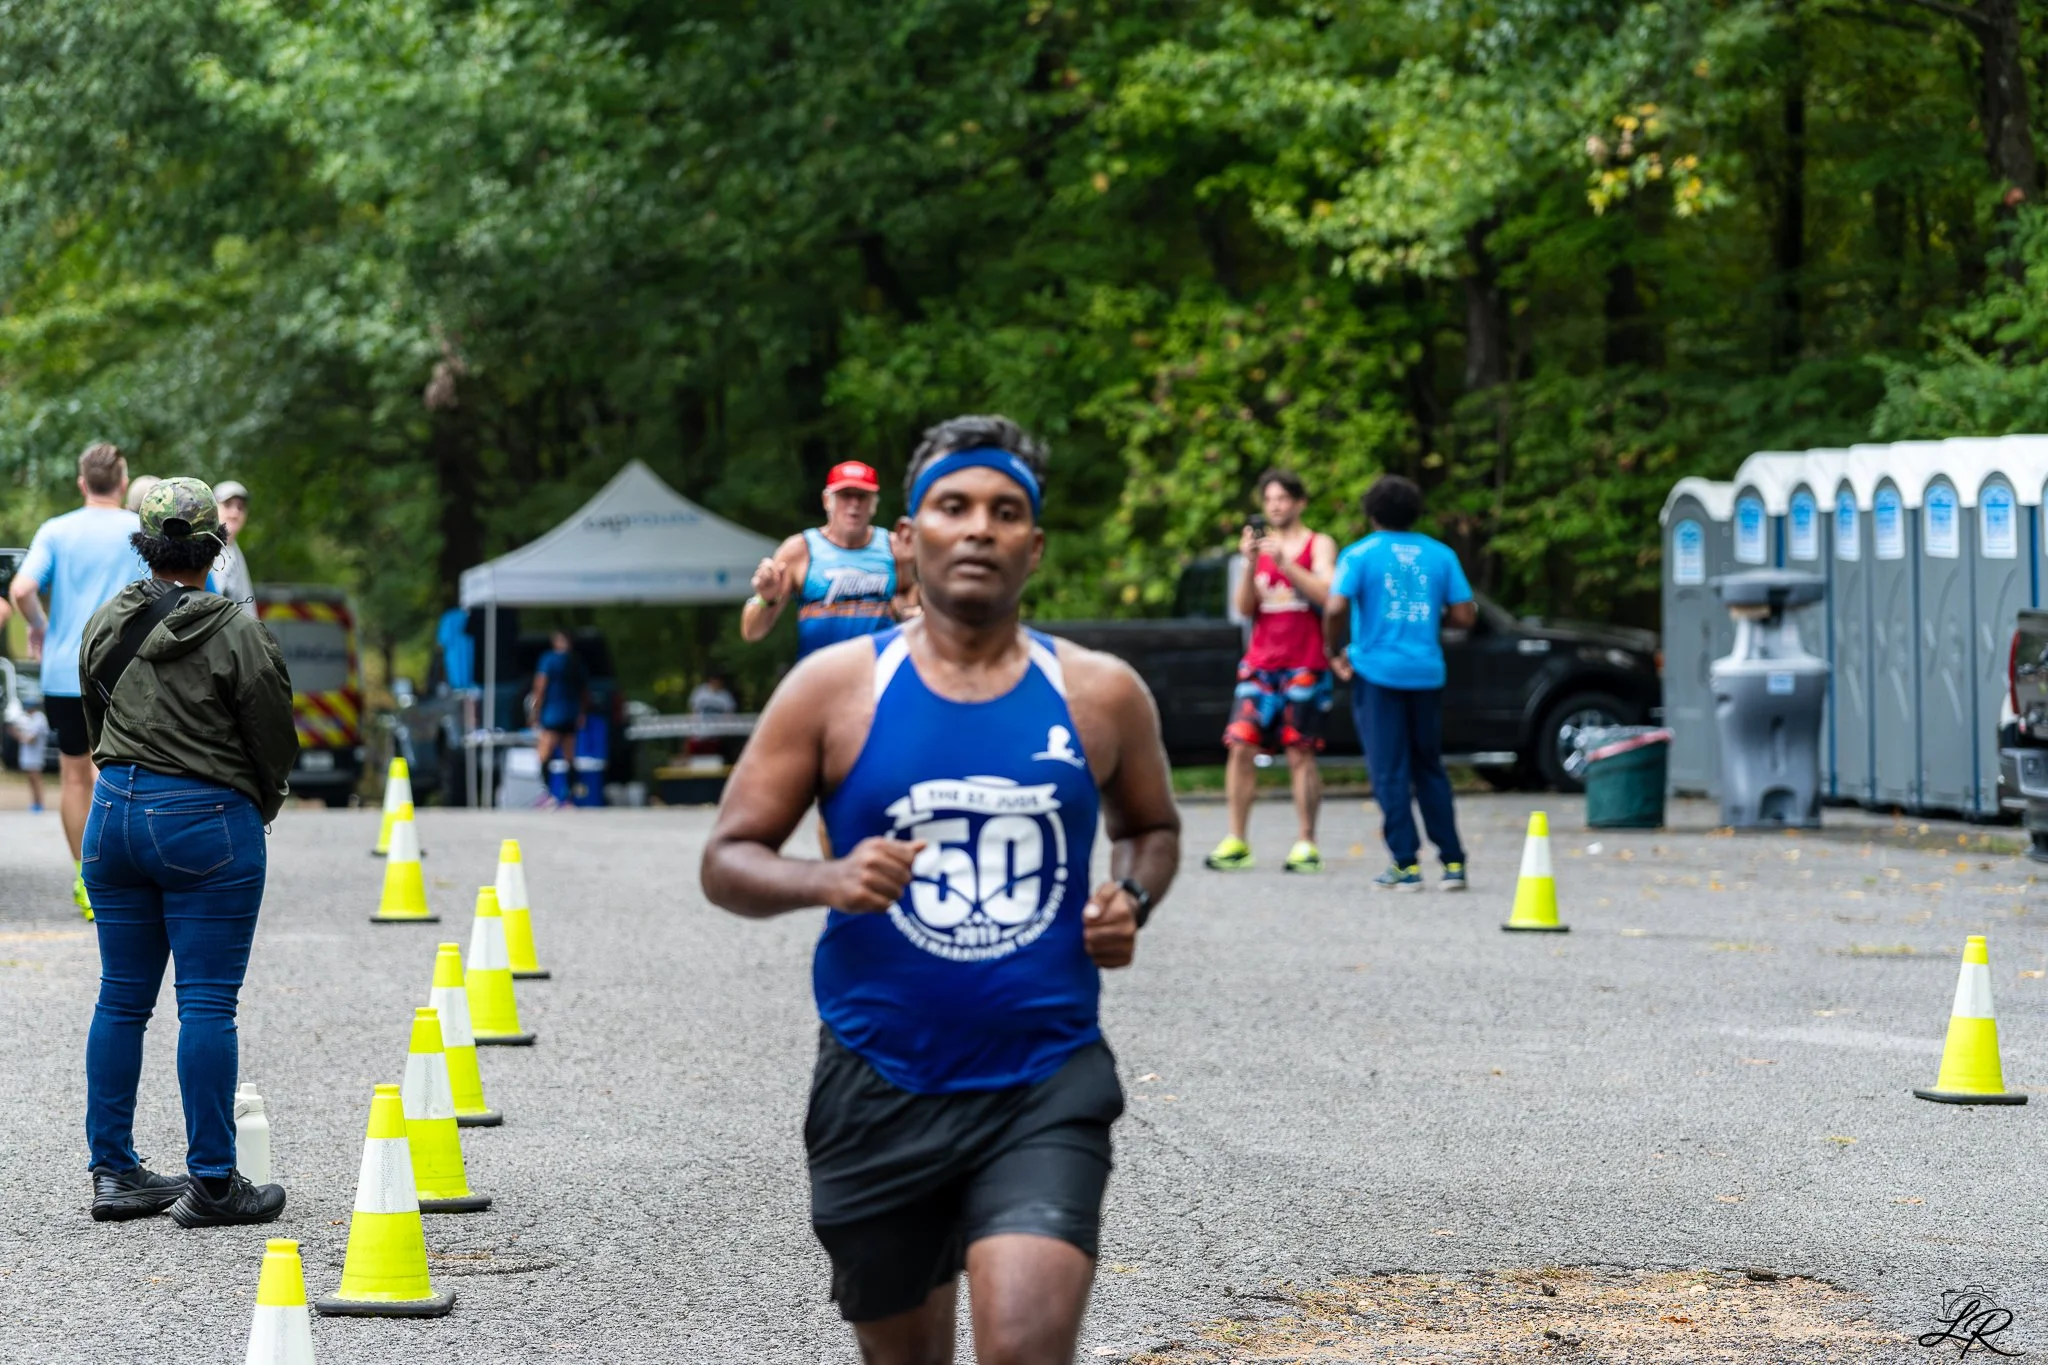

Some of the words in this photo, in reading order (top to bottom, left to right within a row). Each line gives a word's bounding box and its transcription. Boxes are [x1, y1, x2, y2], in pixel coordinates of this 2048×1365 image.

[927, 789, 959, 802] THE
[967, 791, 990, 805] ST.
[911, 814, 1044, 930] 50
